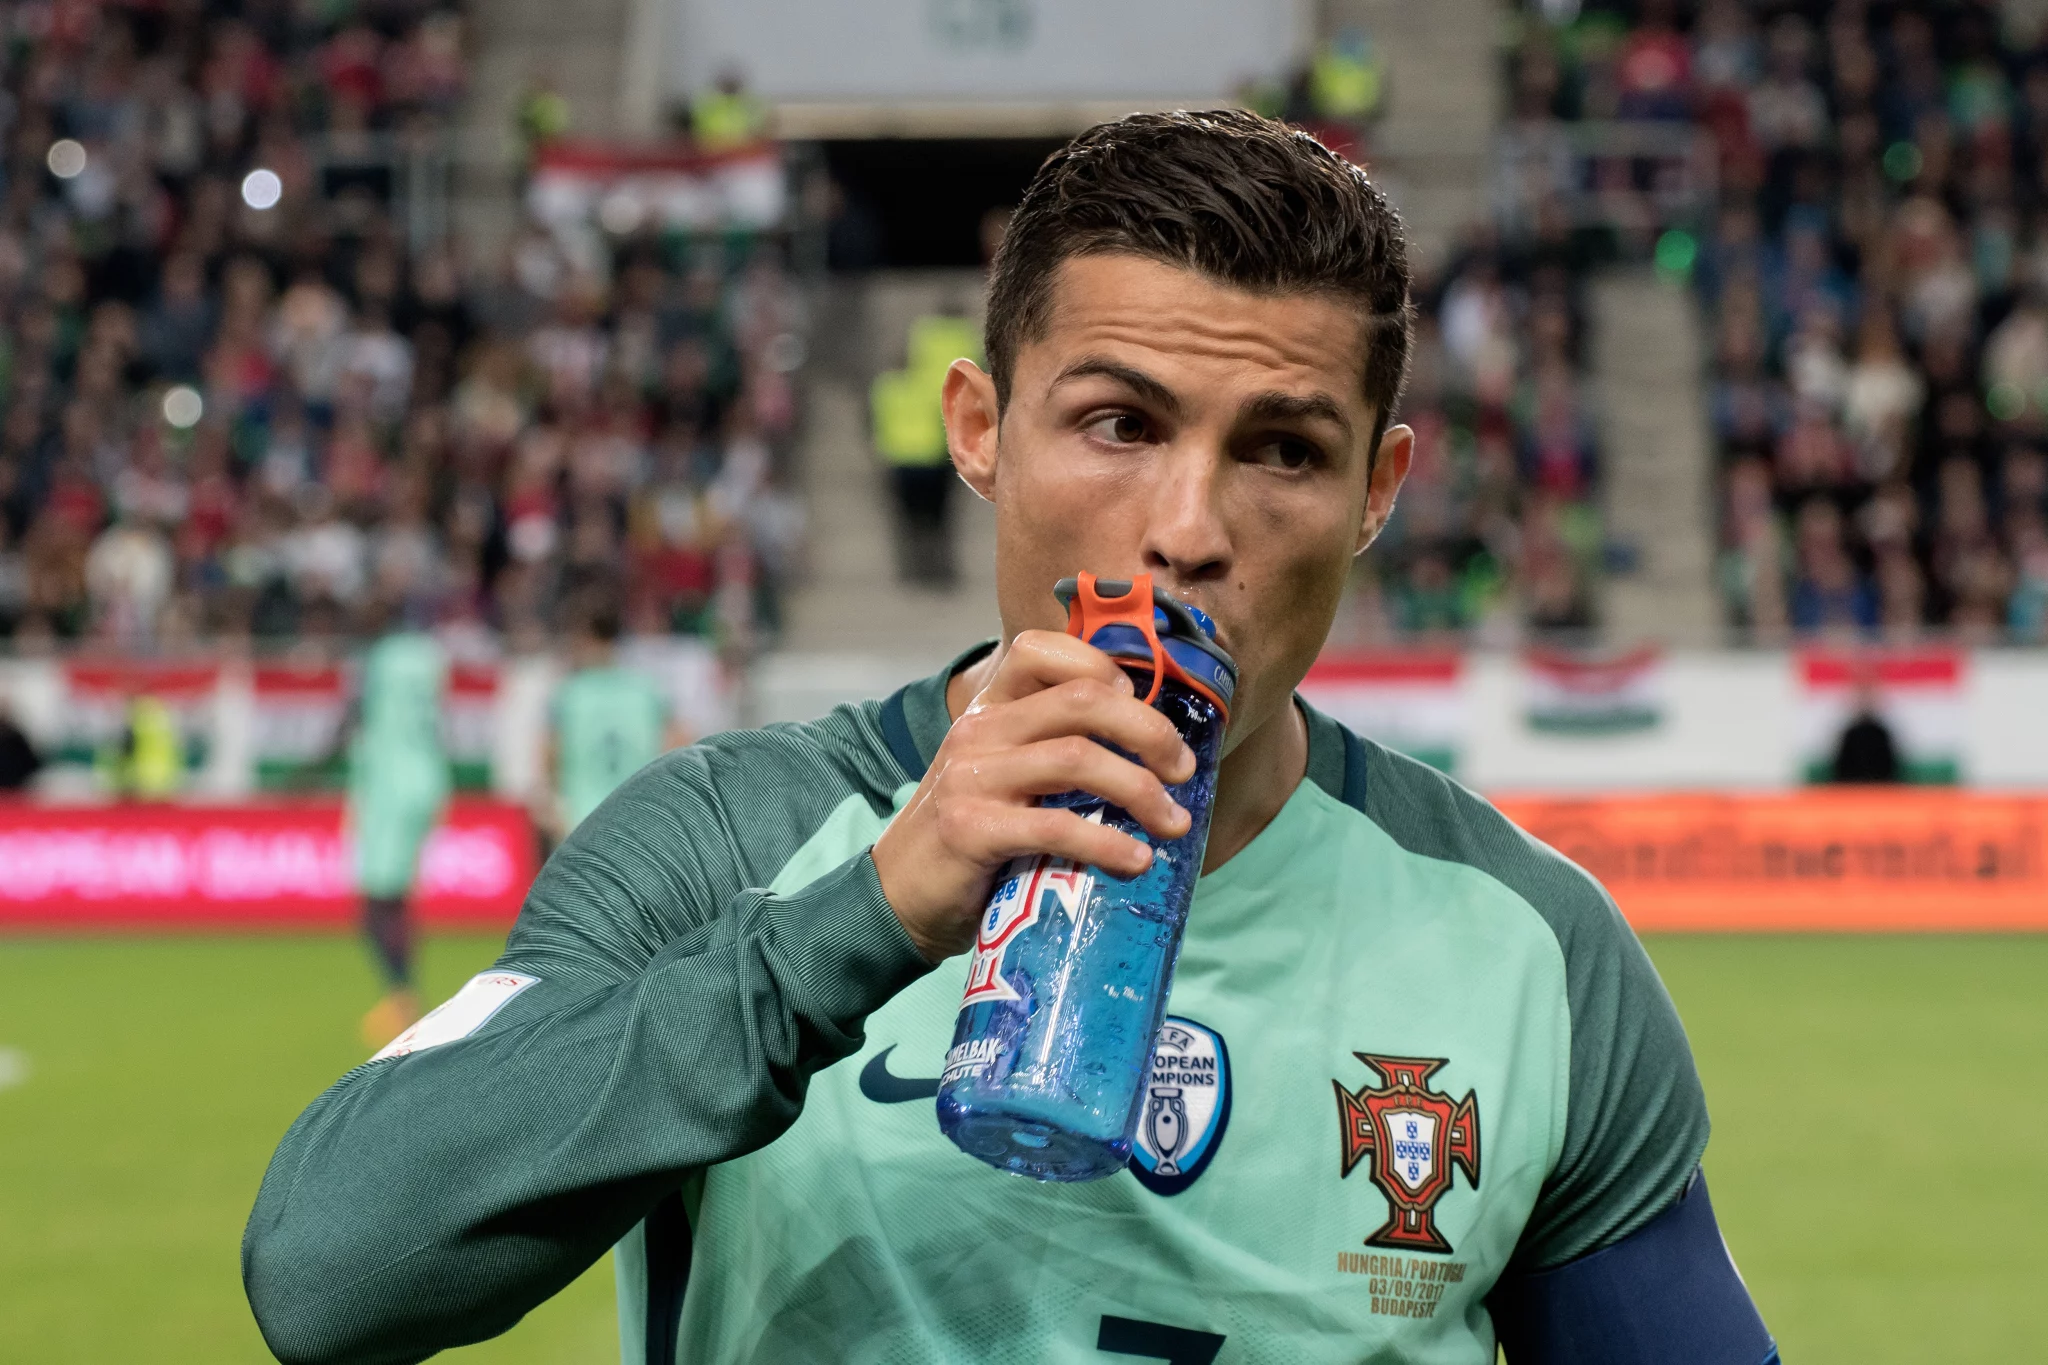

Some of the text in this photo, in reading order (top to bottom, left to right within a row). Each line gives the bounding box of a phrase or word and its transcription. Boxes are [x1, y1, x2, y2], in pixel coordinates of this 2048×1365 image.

[1154, 1055, 1215, 1071] OPEAN
[1152, 1072, 1215, 1086] MPIONS
[1368, 1277, 1445, 1301] 03/09/2017
